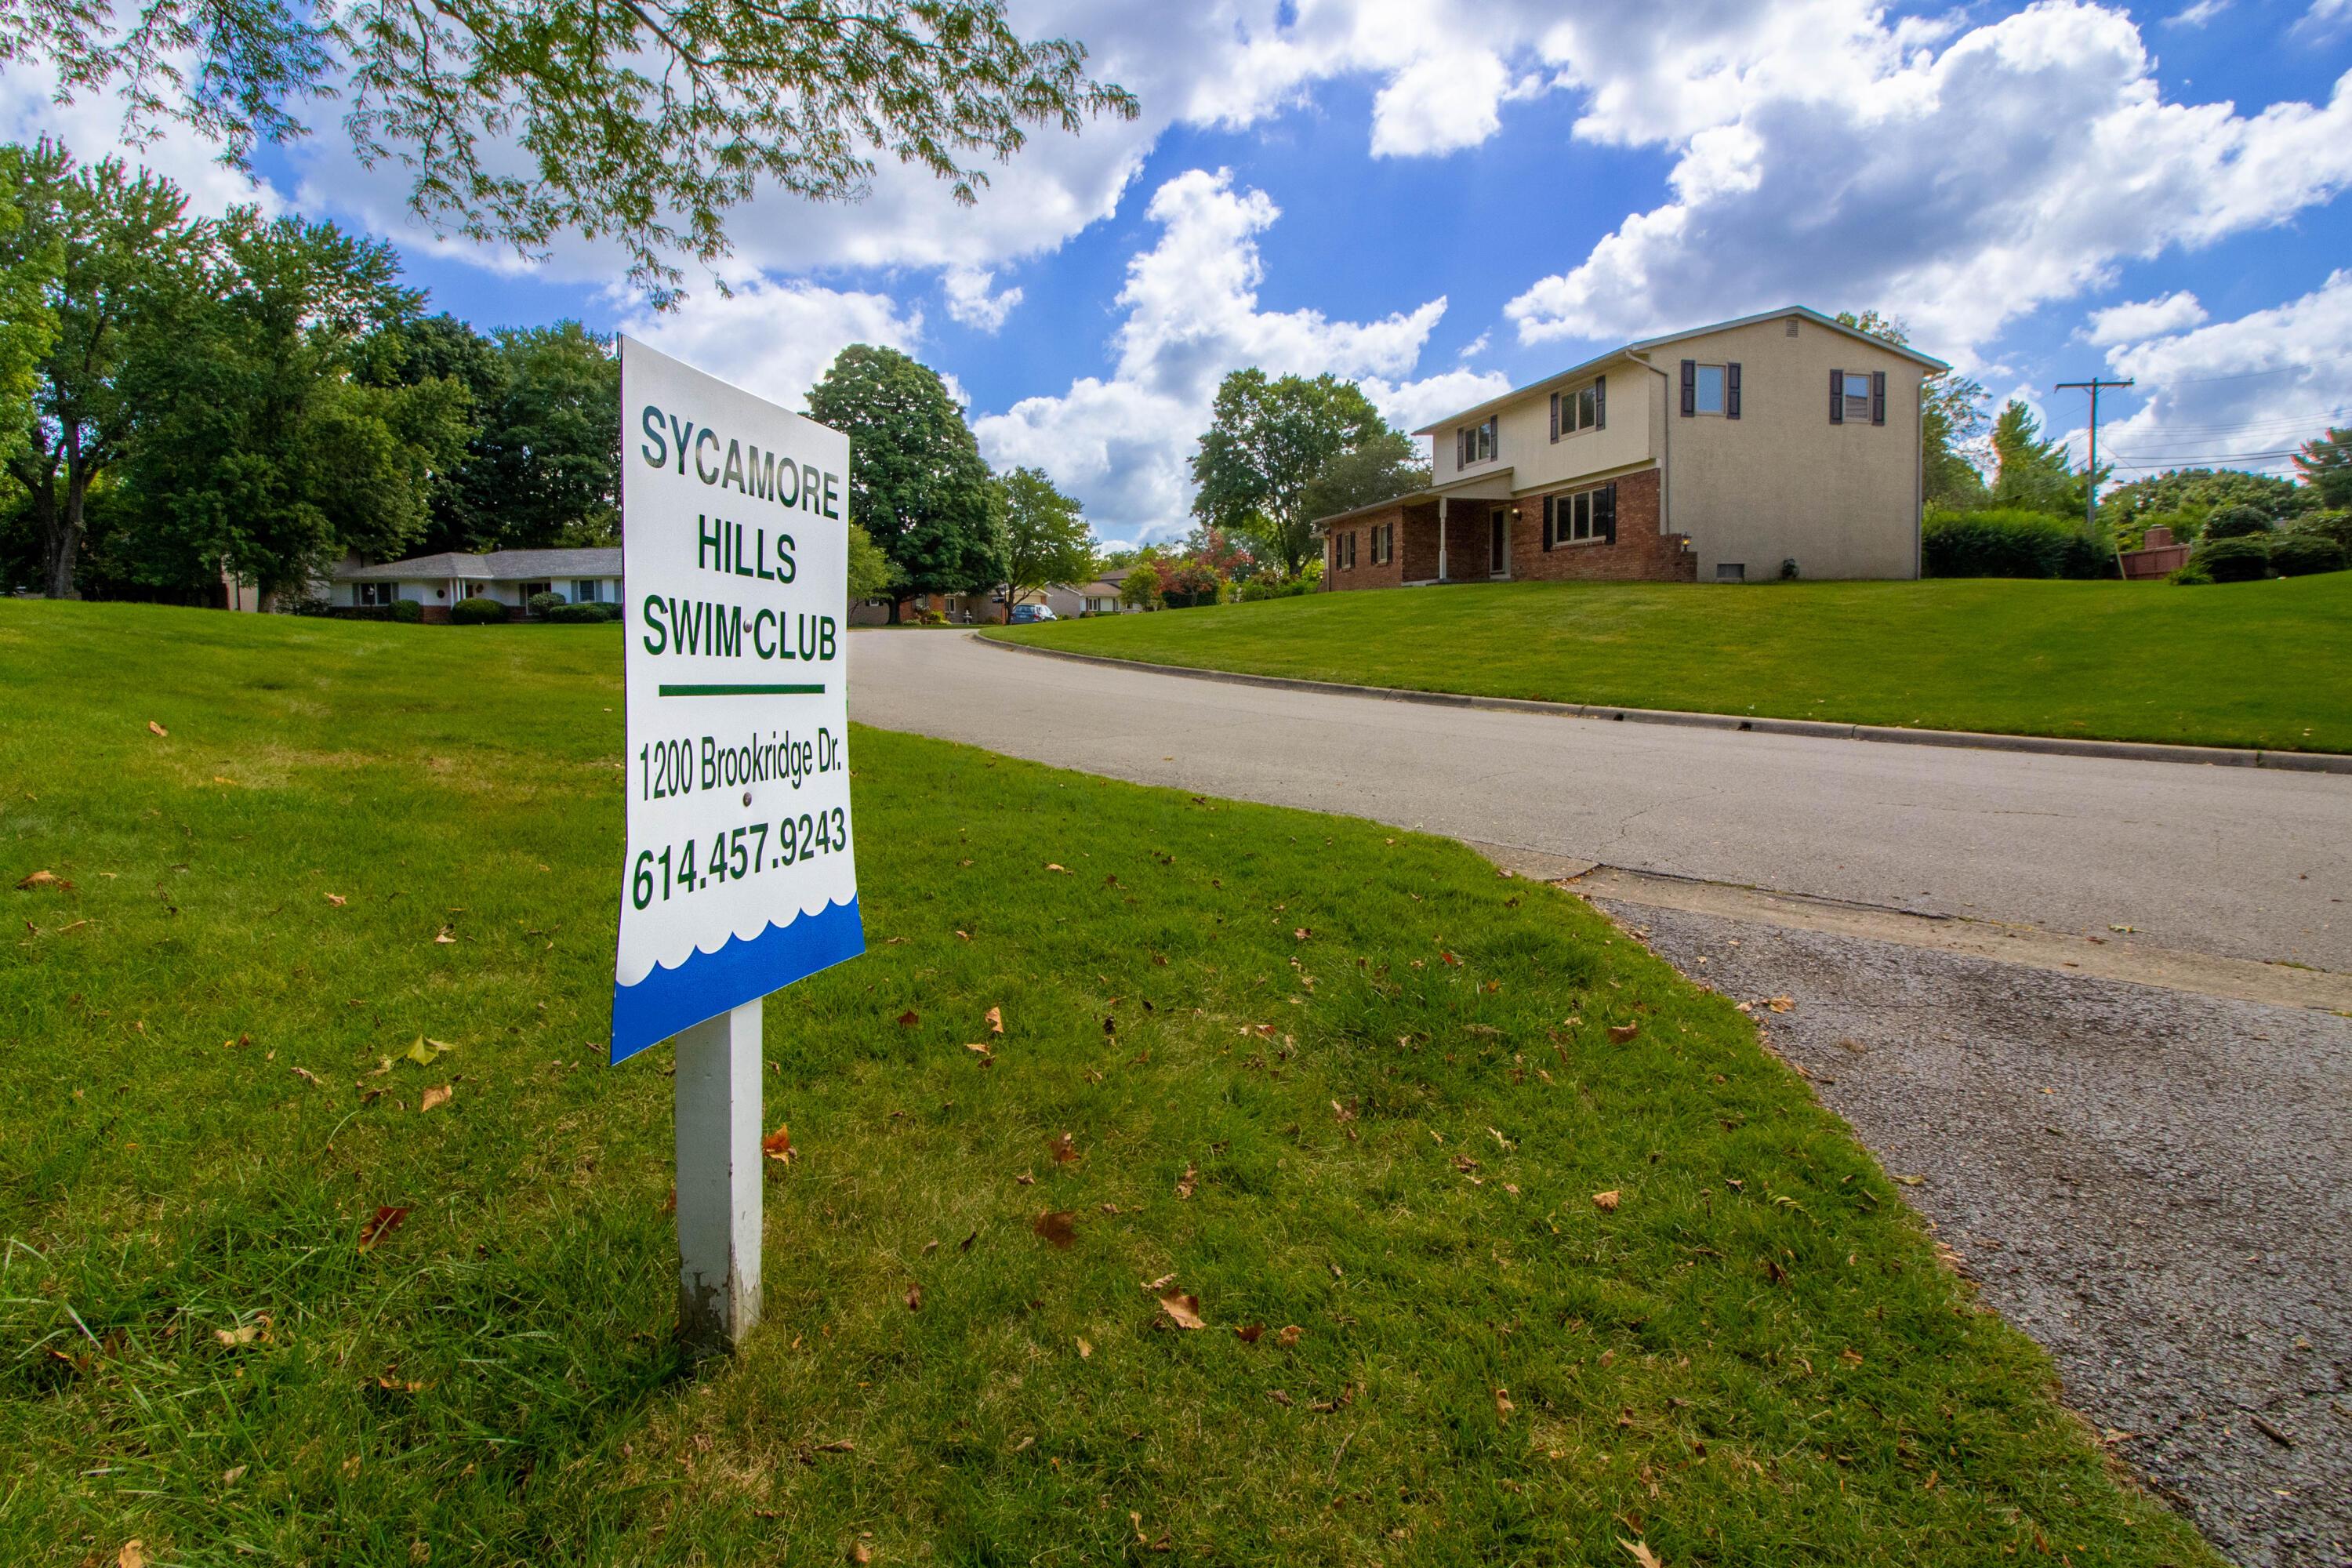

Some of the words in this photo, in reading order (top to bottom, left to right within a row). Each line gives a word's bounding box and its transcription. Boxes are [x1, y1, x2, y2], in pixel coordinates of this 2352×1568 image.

[641, 405, 839, 521] SYCAMORE
[699, 514, 797, 584] HILLS
[643, 594, 742, 658] SWIM
[753, 608, 837, 662] CLUB
[640, 738, 693, 801] 1200
[701, 731, 813, 789] Brookridge
[818, 727, 841, 773] Dr.
[633, 807, 846, 910] 614.457.9243
